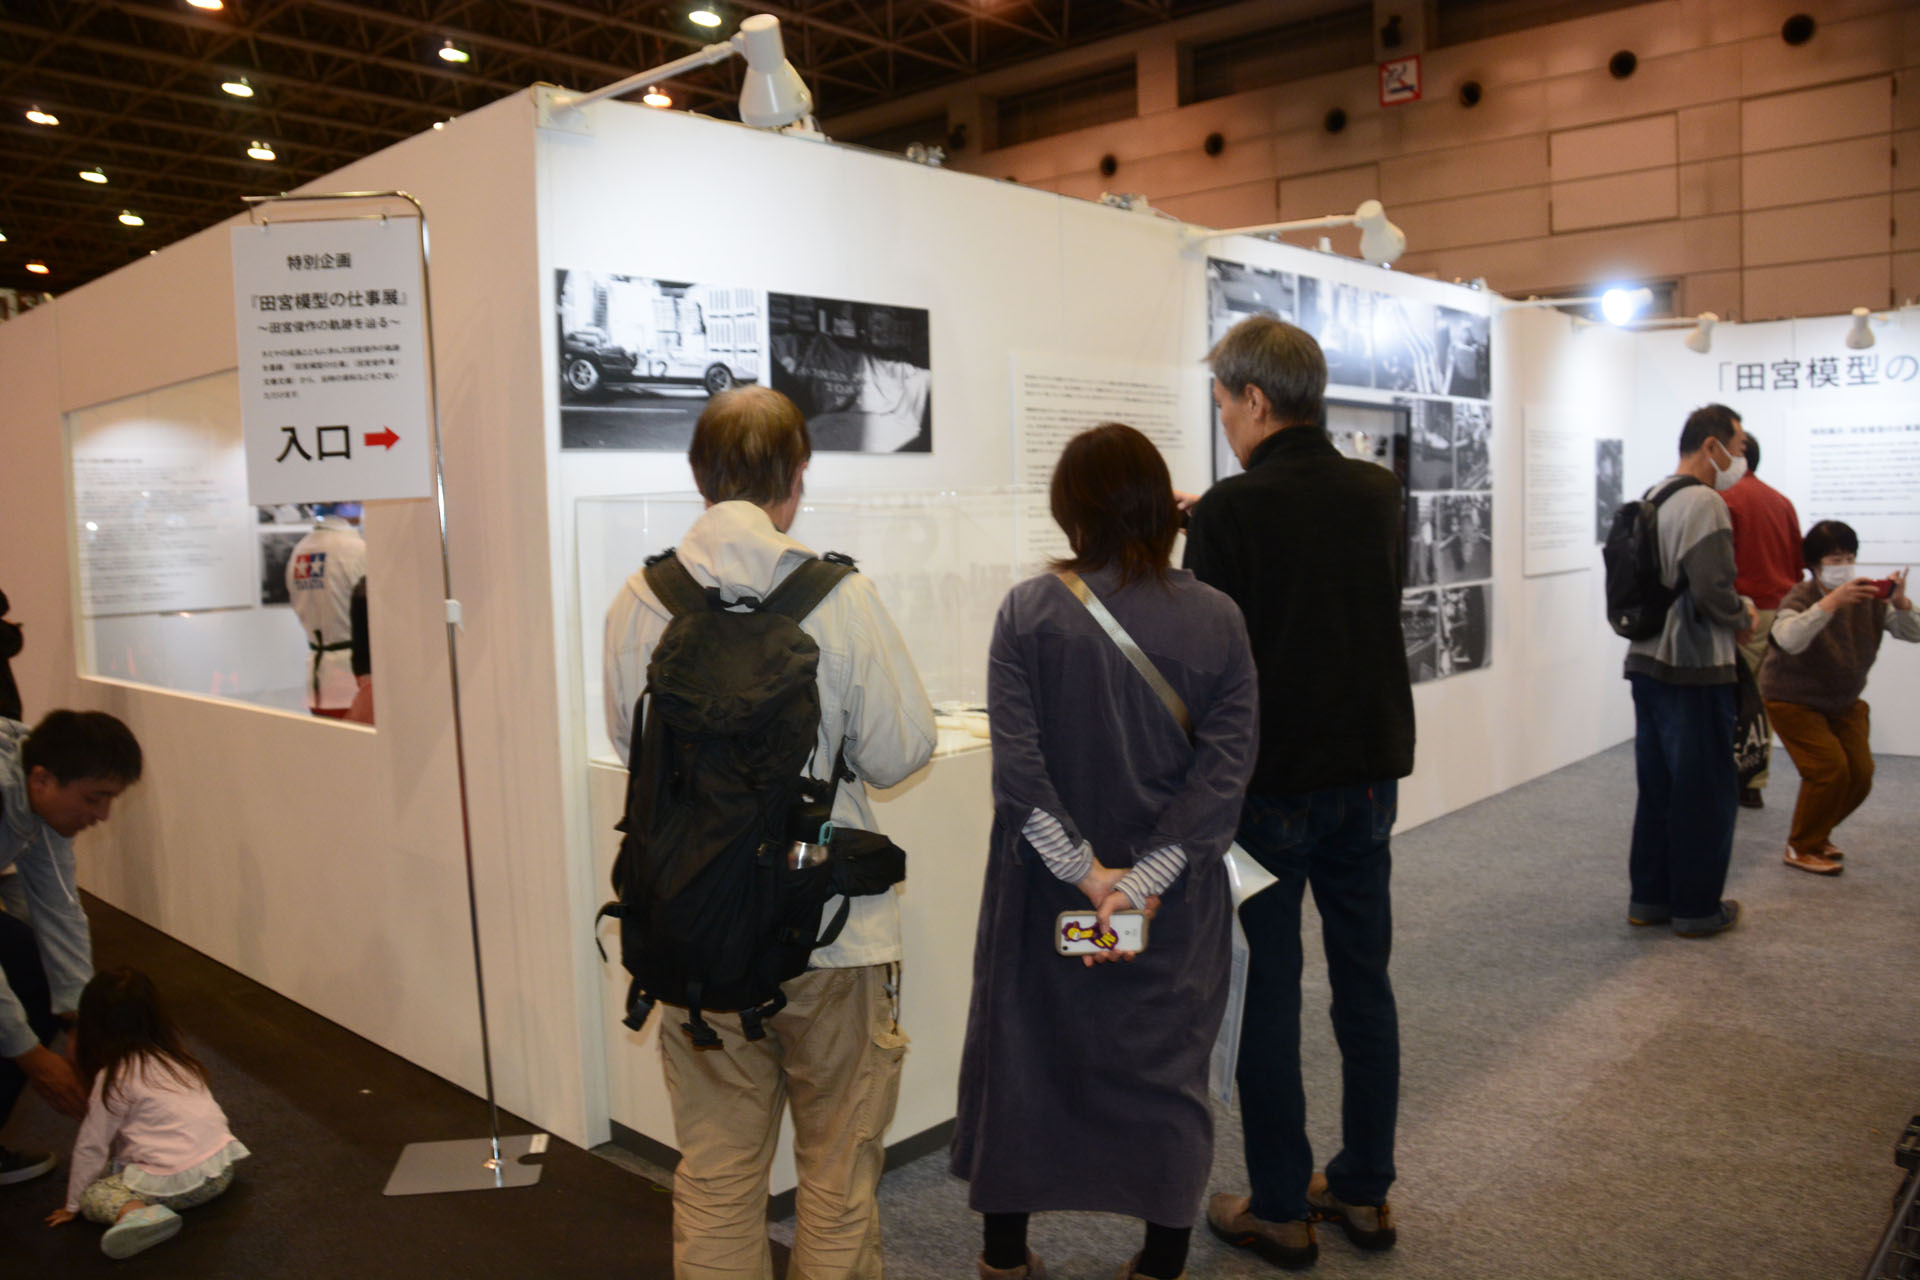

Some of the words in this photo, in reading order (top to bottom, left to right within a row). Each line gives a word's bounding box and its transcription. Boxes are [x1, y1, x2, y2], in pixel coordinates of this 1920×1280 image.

[287, 253, 352, 270] 特別企画
[1718, 354, 1920, 392] 「田宮模型の
[276, 424, 352, 463] 入口
